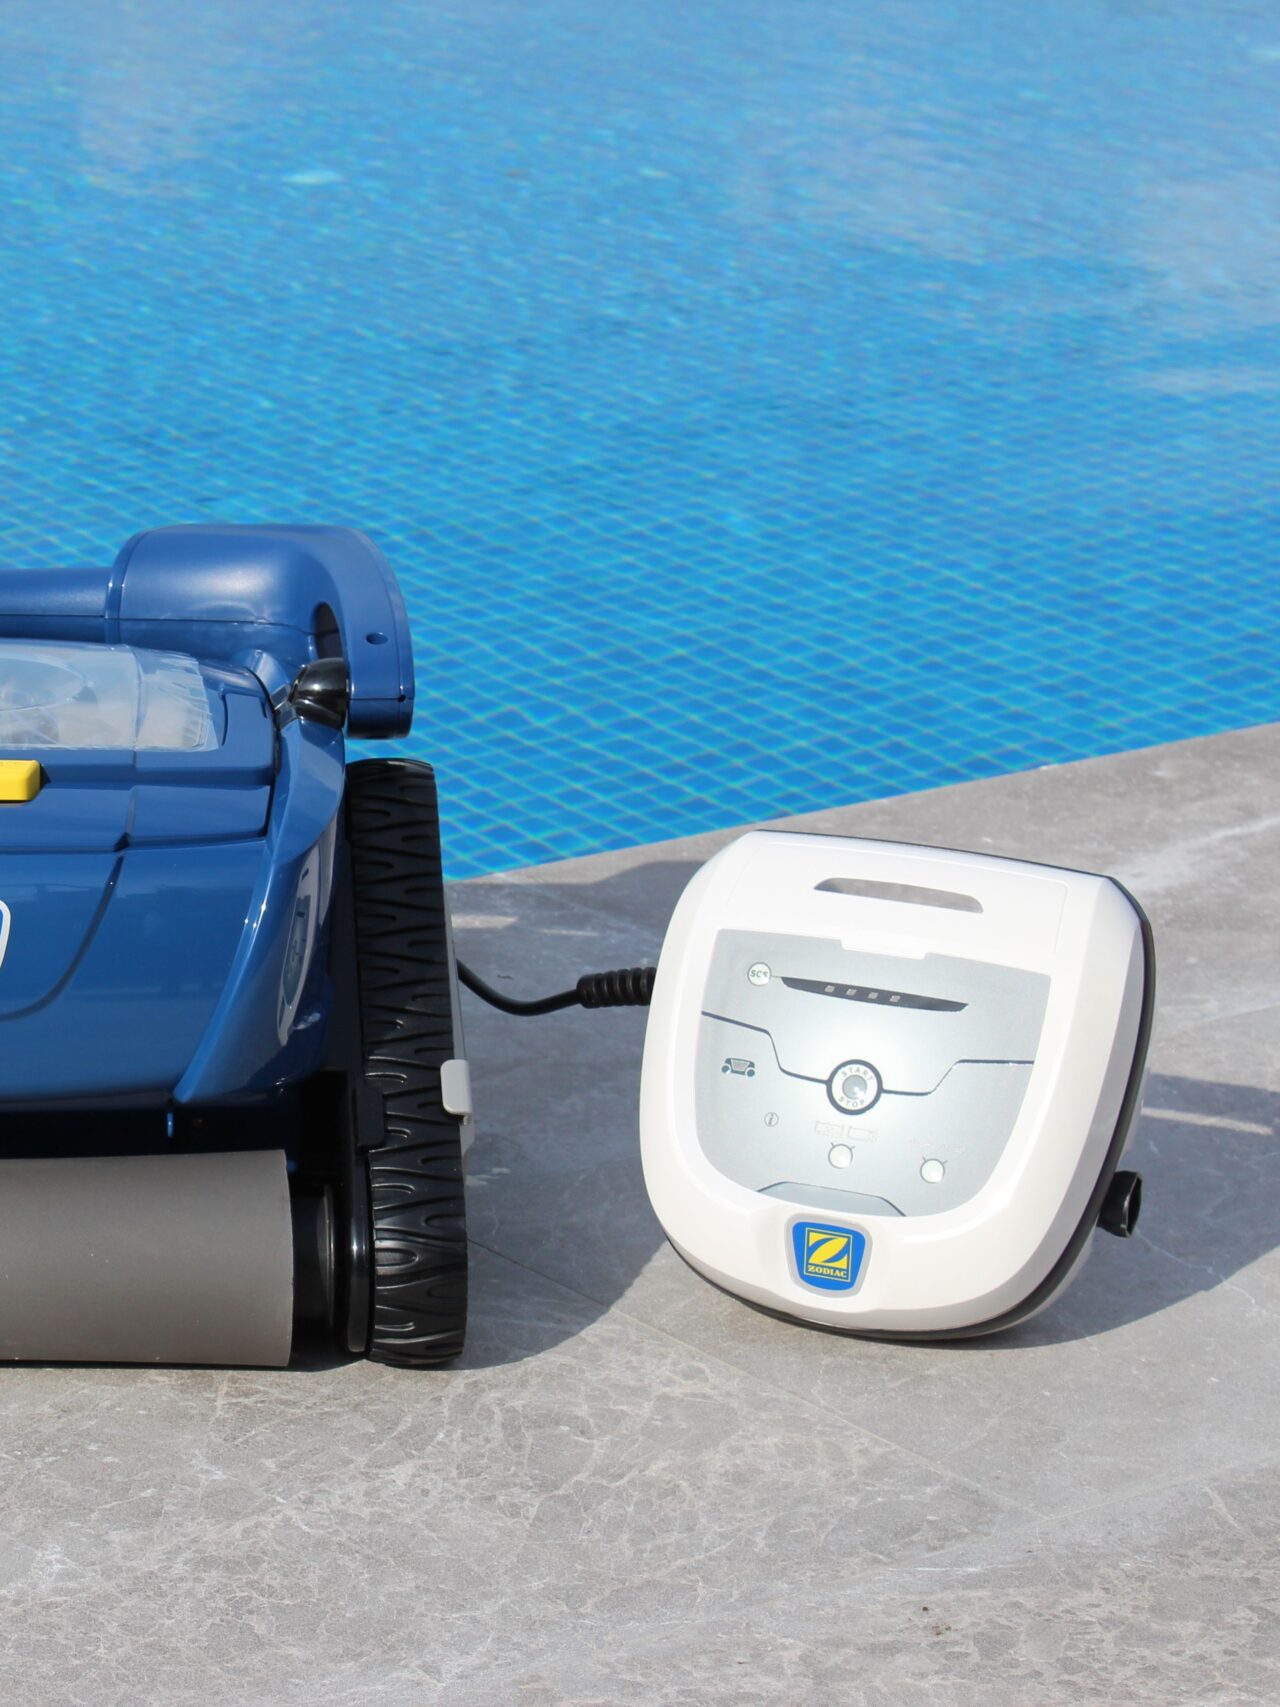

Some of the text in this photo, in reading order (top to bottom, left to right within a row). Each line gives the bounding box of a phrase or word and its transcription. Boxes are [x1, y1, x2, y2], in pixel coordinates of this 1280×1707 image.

[841, 1066, 873, 1081] START
[839, 1096, 866, 1108] STOP
[807, 1264, 848, 1278] ZODIAC
